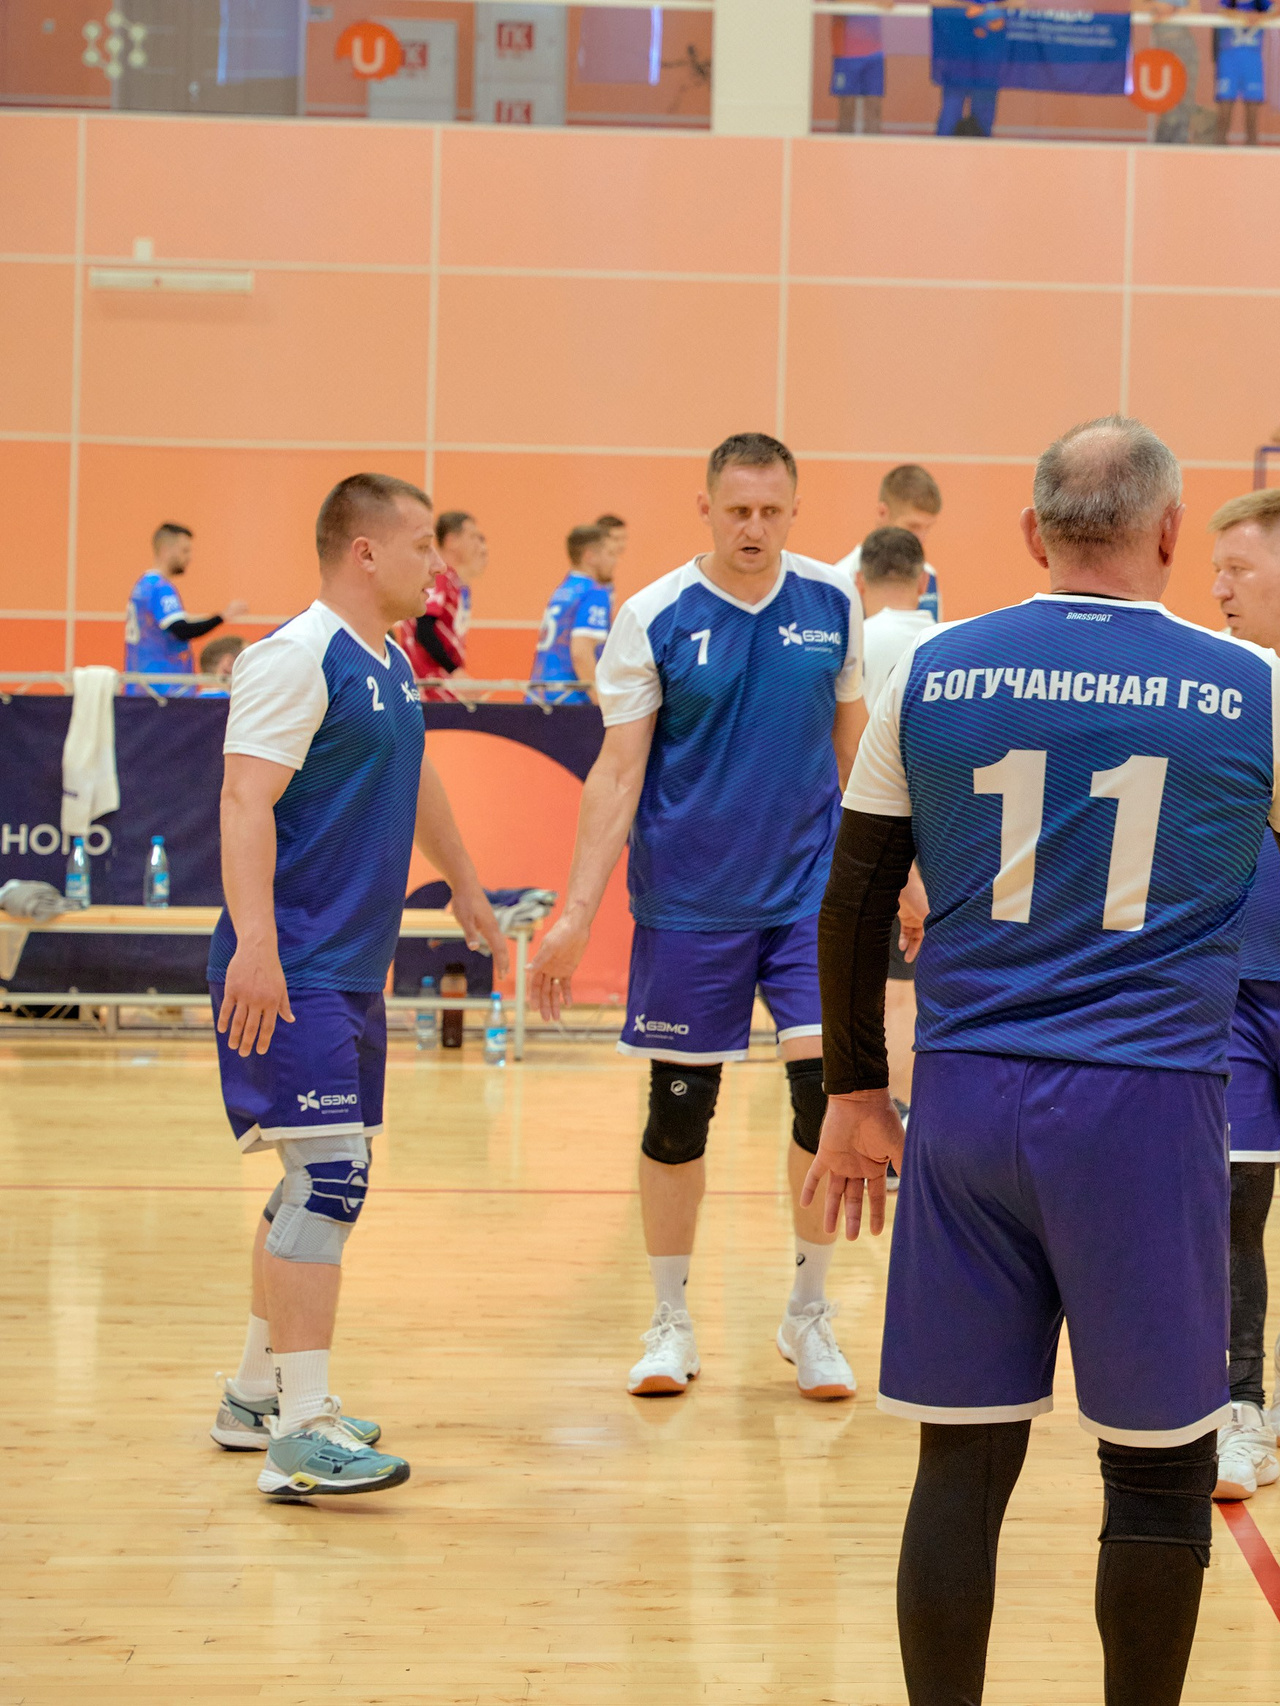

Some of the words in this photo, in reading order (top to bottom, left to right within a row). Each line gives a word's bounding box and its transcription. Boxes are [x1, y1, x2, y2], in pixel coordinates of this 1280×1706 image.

[690, 629, 711, 665] 7
[366, 676, 385, 711] 2
[922, 667, 1168, 706] БОГУЧАНСКАЯ
[1178, 679, 1243, 720] ГЭС
[972, 749, 1169, 932] 11
